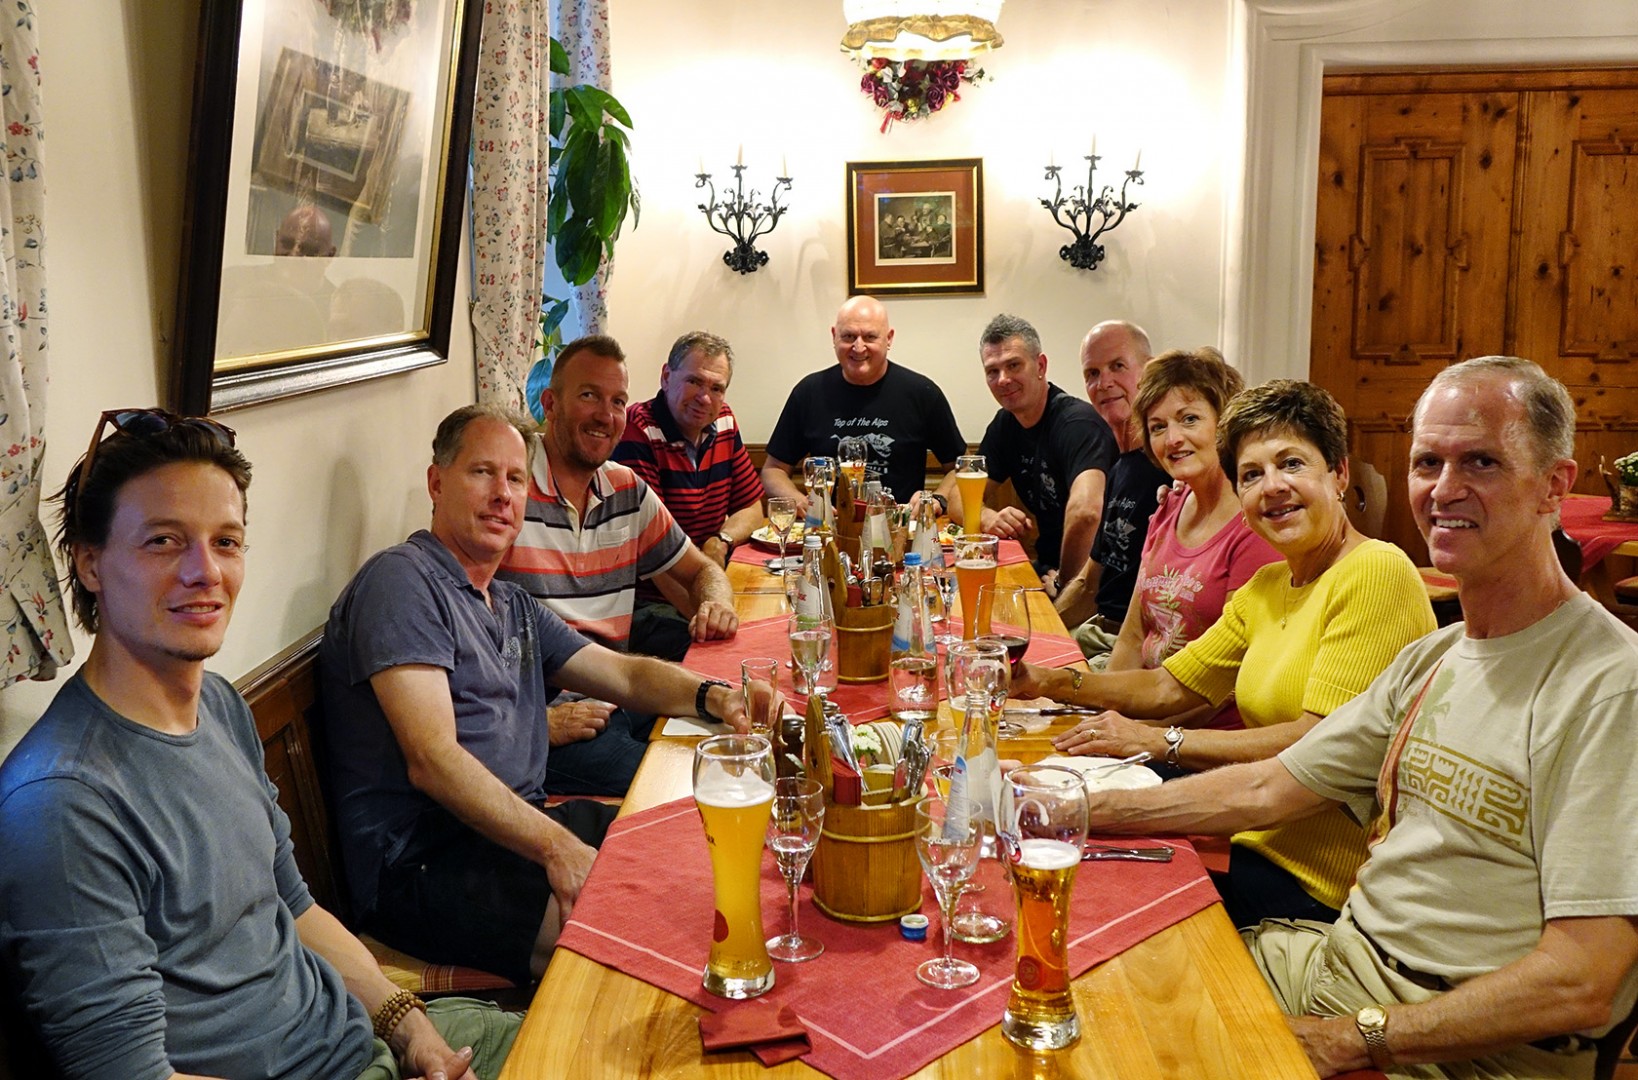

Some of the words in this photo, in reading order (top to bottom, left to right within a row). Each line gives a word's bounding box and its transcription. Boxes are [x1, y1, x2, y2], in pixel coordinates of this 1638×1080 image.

[834, 417, 846, 428] Top
[846, 417, 857, 426] of
[857, 417, 870, 426] the
[871, 417, 889, 428] Alps
